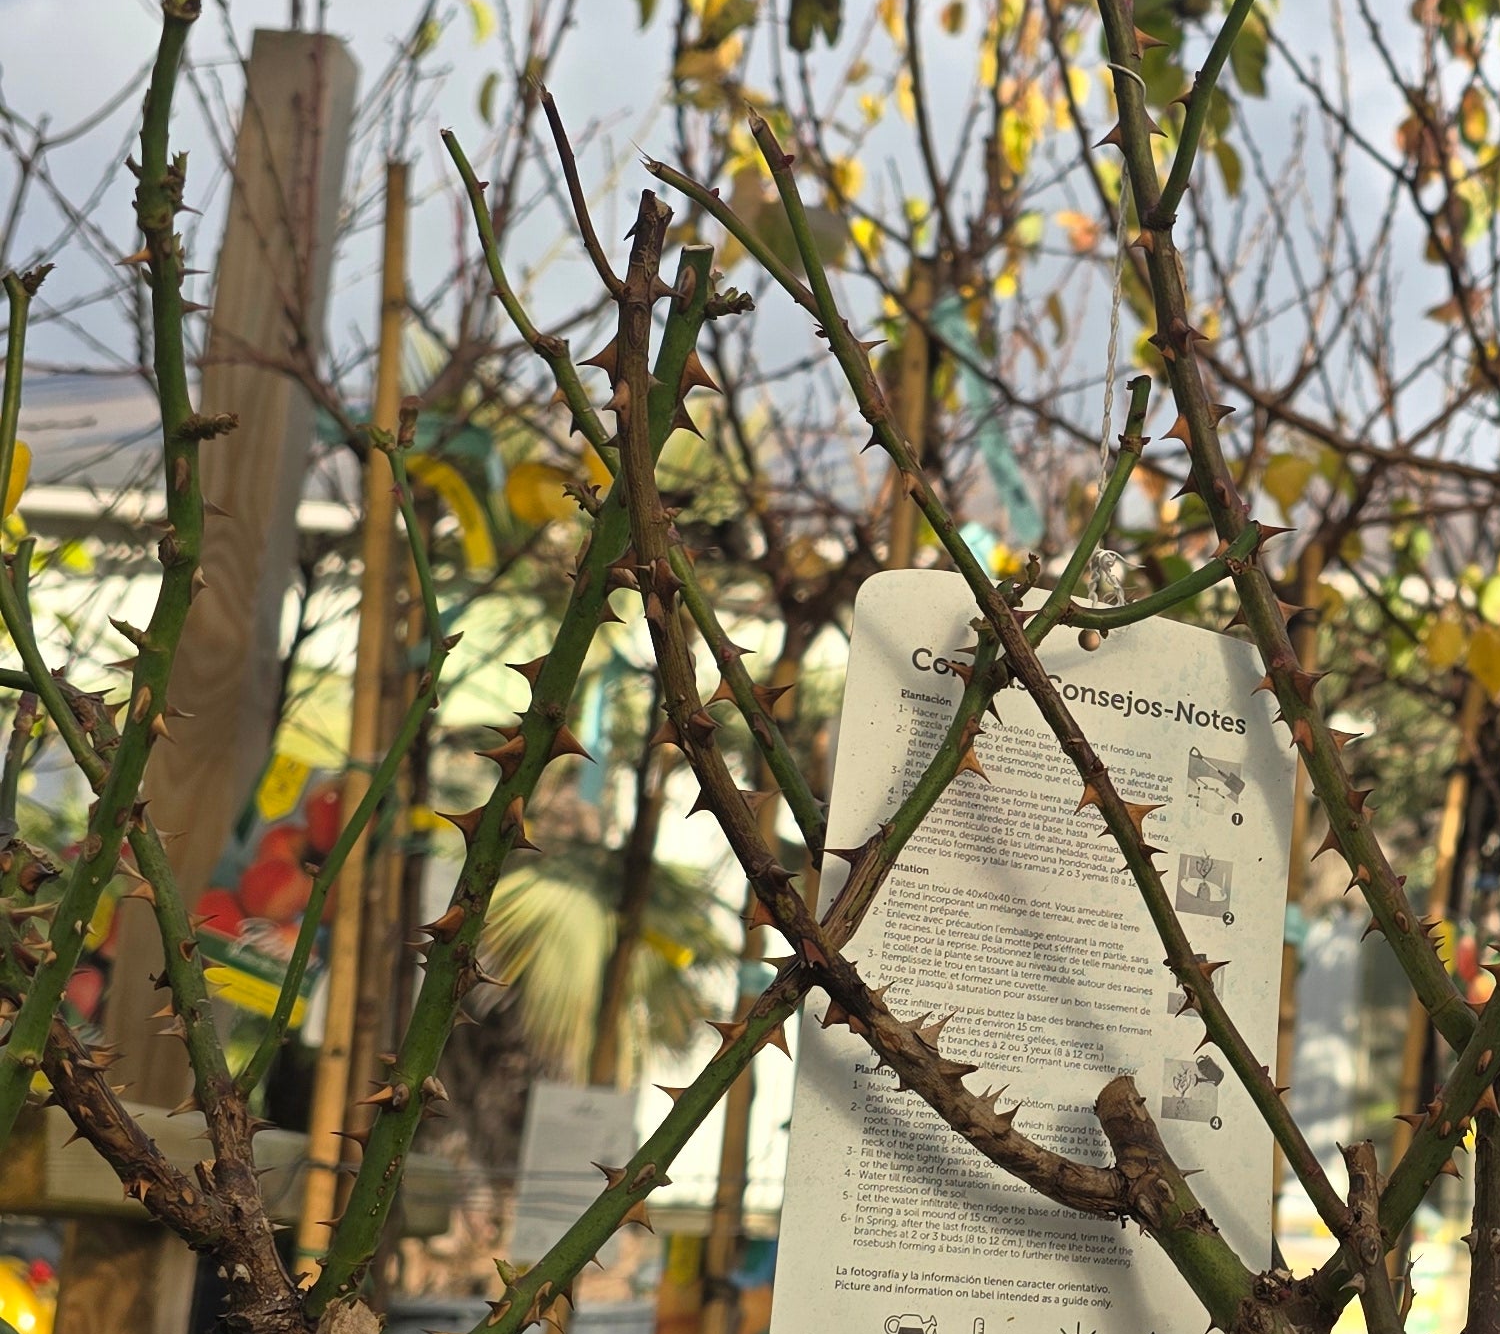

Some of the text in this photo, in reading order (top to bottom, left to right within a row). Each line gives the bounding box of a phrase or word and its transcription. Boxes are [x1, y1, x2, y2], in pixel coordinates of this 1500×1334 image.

[900, 688, 952, 707] Plantación
[889, 876, 916, 889] Faites
[917, 882, 930, 891] un
[931, 883, 951, 894] trou
[951, 886, 964, 896] de
[1054, 901, 1076, 913] Vous
[1076, 906, 1123, 920] ameublirez
[853, 1225, 897, 1238] branches
[898, 1229, 909, 1239] at
[910, 1229, 917, 1240] 2
[918, 1232, 930, 1240] or
[931, 1230, 938, 1241] 3
[939, 1232, 963, 1243] buds
[976, 1235, 987, 1245] to
[988, 1235, 1000, 1245] 12
[1025, 1238, 1047, 1249] then
[1048, 1239, 1066, 1251] free
[1067, 1242, 1083, 1252] the
[1084, 1242, 1106, 1254] base
[1106, 1244, 1117, 1254] of
[1118, 1245, 1133, 1256] the
[854, 1213, 864, 1224] In
[900, 1217, 923, 1228] after
[924, 1219, 941, 1230] the
[942, 1221, 958, 1231] last
[990, 1226, 1025, 1237] remove
[1026, 1227, 1042, 1238] the
[1080, 1232, 1099, 1242] trim
[1100, 1233, 1115, 1244] the
[852, 1237, 896, 1249] rosebush
[898, 1239, 936, 1254] forming
[945, 1243, 970, 1254] basin
[971, 1245, 981, 1255] in
[982, 1247, 1008, 1257] order
[1009, 1249, 1020, 1258] to
[1021, 1249, 1053, 1260] further
[1054, 1252, 1070, 1262] the
[1071, 1252, 1091, 1263] later
[835, 1265, 847, 1275] La
[849, 1266, 899, 1280] fotografía
[901, 1271, 908, 1282] y
[909, 1270, 919, 1280] la
[920, 1271, 981, 1284] información
[983, 1276, 1014, 1287] tienen
[1015, 1279, 1055, 1290] caracter
[833, 1279, 871, 1291] Picture
[872, 1283, 892, 1293] and
[894, 1283, 953, 1296] information
[954, 1289, 969, 1298] on
[970, 1288, 994, 1299] label
[996, 1290, 1040, 1302] intended
[1040, 1295, 1052, 1303] as
[1061, 1295, 1089, 1307] guide
[1090, 1297, 1113, 1310] only.
